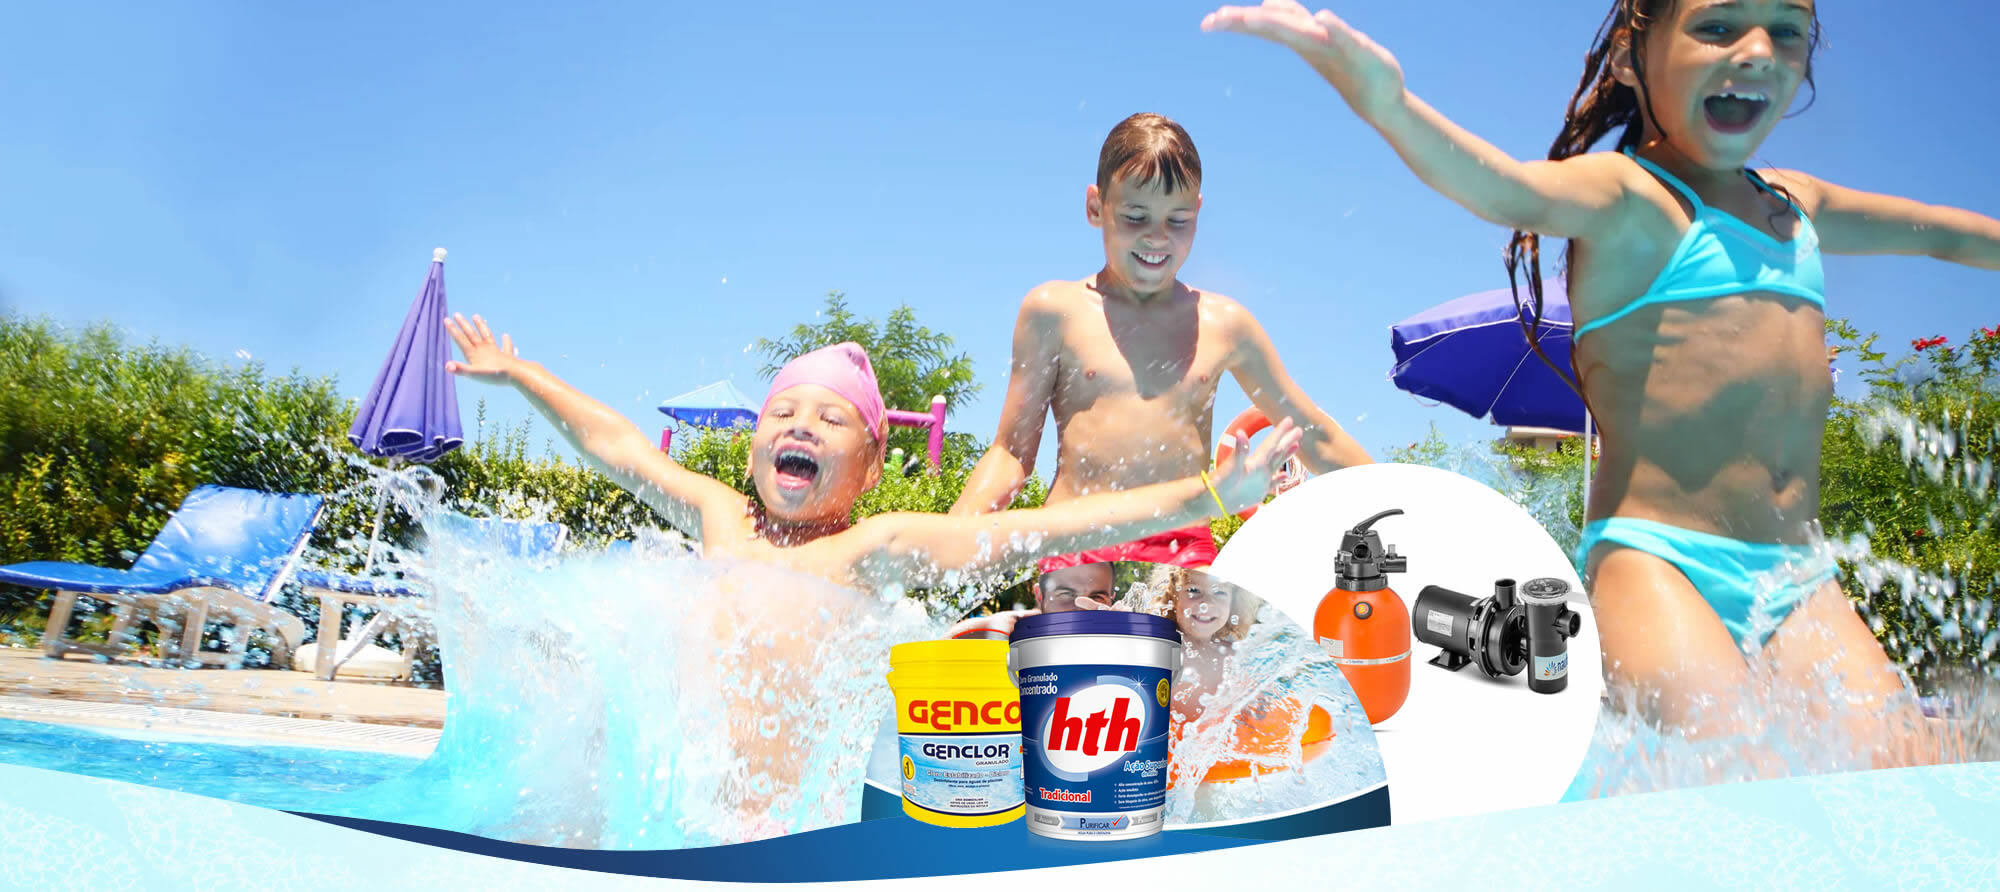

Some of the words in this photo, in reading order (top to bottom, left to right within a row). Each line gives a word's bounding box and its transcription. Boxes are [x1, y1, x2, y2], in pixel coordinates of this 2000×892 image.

[1020, 682, 1058, 696] oncentrado
[908, 700, 1021, 730] GENCO
[1047, 697, 1141, 756] hth
[922, 743, 1010, 760] GENCLOR
[1123, 760, 1145, 773] Ação
[1039, 788, 1091, 802] Tradicional
